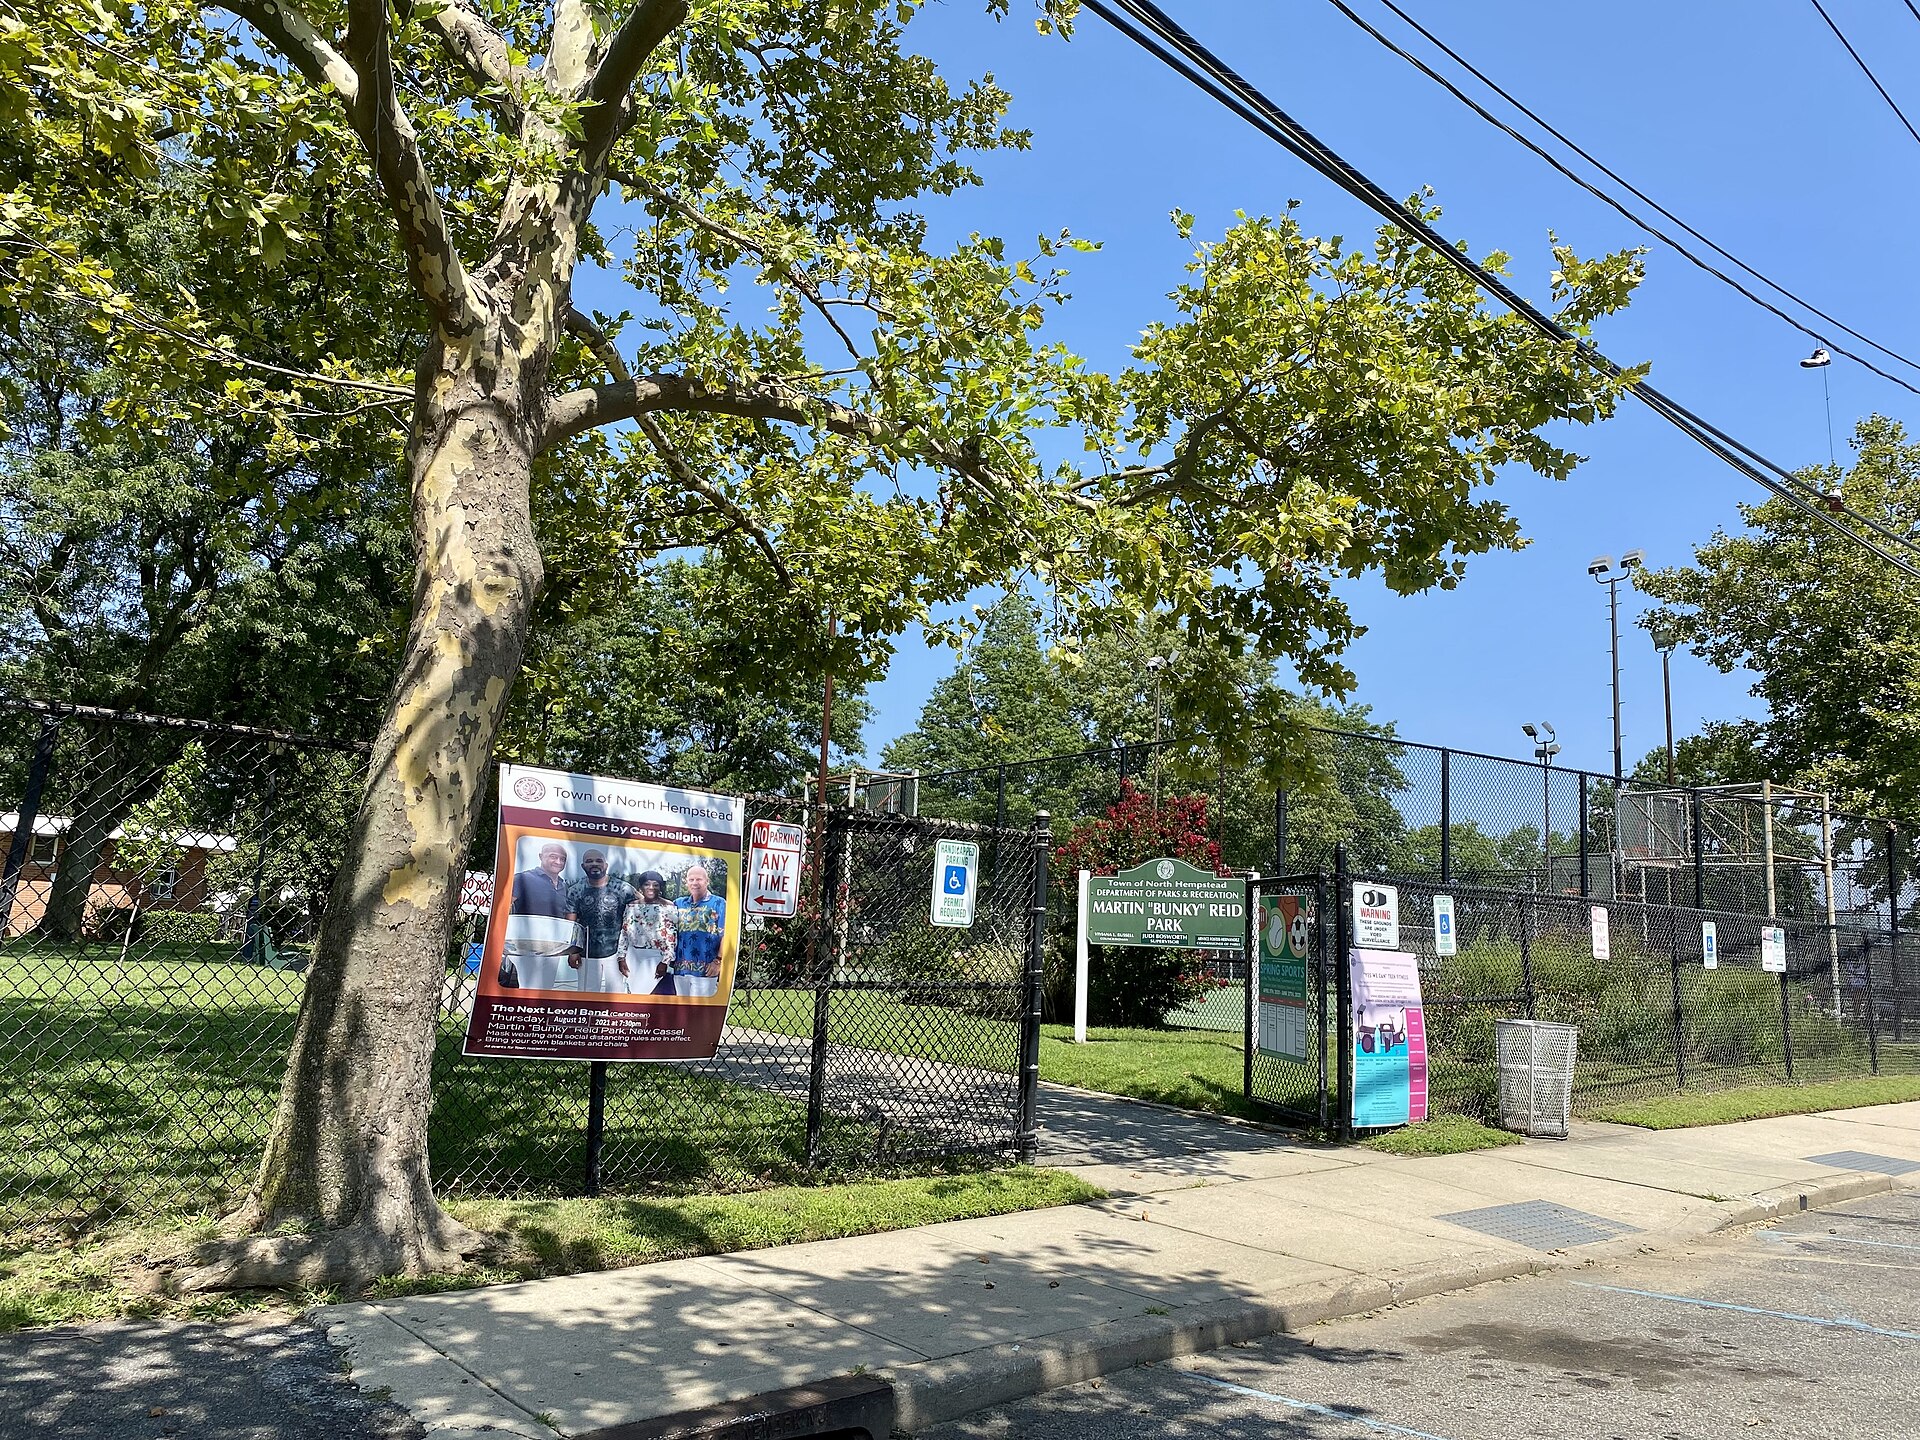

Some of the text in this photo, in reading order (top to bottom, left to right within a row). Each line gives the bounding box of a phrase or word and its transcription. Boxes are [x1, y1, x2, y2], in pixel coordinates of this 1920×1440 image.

[553, 786, 592, 802] Town
[597, 793, 612, 804] of
[616, 795, 655, 810] North
[659, 801, 733, 822] Hempstead
[550, 816, 704, 844] Concert by Candlelight
[754, 827, 800, 846] NO PARKING
[940, 844, 975, 857] HANDICAPPED
[761, 853, 789, 871] ANY
[945, 855, 968, 866] PARKING
[757, 873, 790, 892] TIME
[1146, 880, 1172, 888] North
[1175, 881, 1227, 889] Hempstead
[1096, 889, 1143, 898] DEPARTMENT
[1146, 890, 1156, 898] OF
[1190, 892, 1239, 900] RECREATION
[943, 896, 964, 908] PERMIT
[939, 907, 967, 919] REQUIRED
[1092, 901, 1243, 917] MARTIN "BUNKY" REID
[1360, 907, 1391, 920] WARNING
[1147, 917, 1183, 932] PARK
[1260, 963, 1305, 979] SPRING SPORTS
[491, 1004, 515, 1012] The
[516, 1006, 545, 1014] Next
[547, 1007, 577, 1015] Level
[579, 1008, 609, 1016] Band
[487, 1022, 525, 1031] Martin
[490, 1013, 546, 1024] Thursday,
[554, 1016, 577, 1024] August
[578, 1017, 588, 1025] 19,
[619, 1020, 642, 1028] 7:30pm
[485, 1036, 509, 1044] Bring
[511, 1031, 545, 1039] wearing
